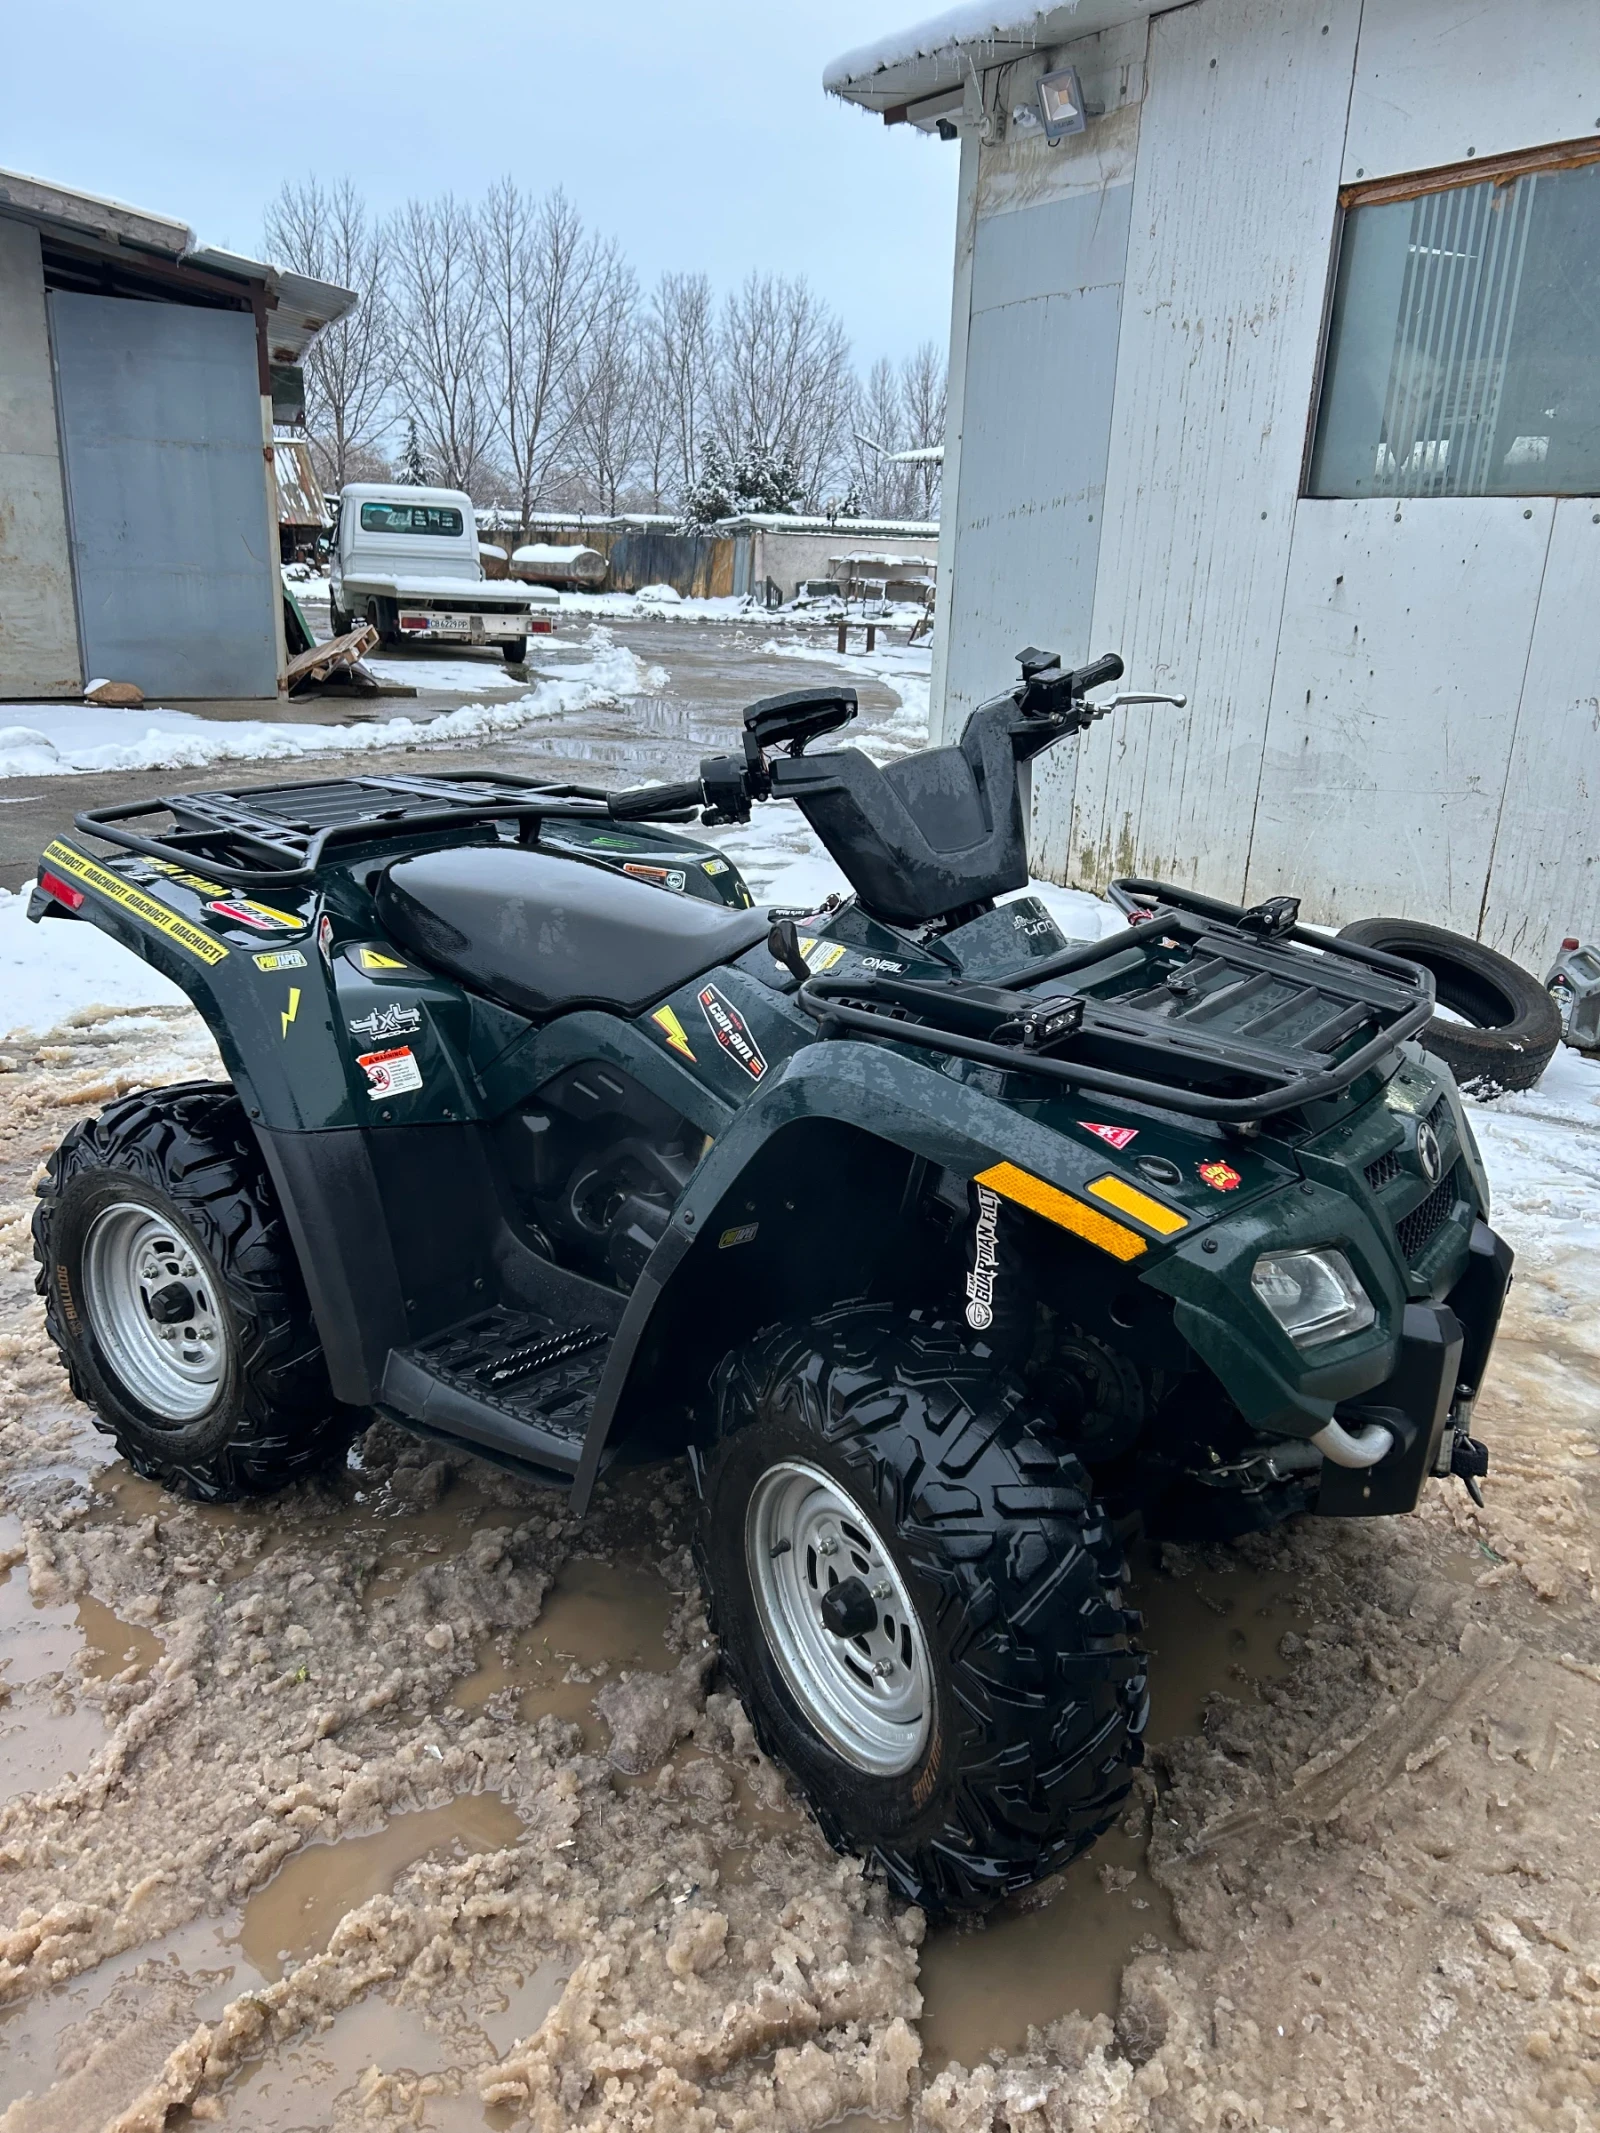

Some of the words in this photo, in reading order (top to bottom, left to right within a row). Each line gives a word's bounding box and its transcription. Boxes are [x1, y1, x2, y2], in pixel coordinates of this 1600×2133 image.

[46, 843, 85, 872] ОПАСНОСТ!
[83, 867, 128, 898] ОПАСНОСТ!
[124, 893, 172, 926] ОПАСНОСТ!
[169, 922, 223, 961] ОПАСНОСТ!
[1024, 920, 1054, 936] 400
[374, 1051, 404, 1062] WARNING
[56, 1264, 78, 1320] BULLDOG
[968, 1275, 976, 1295] TEAM
